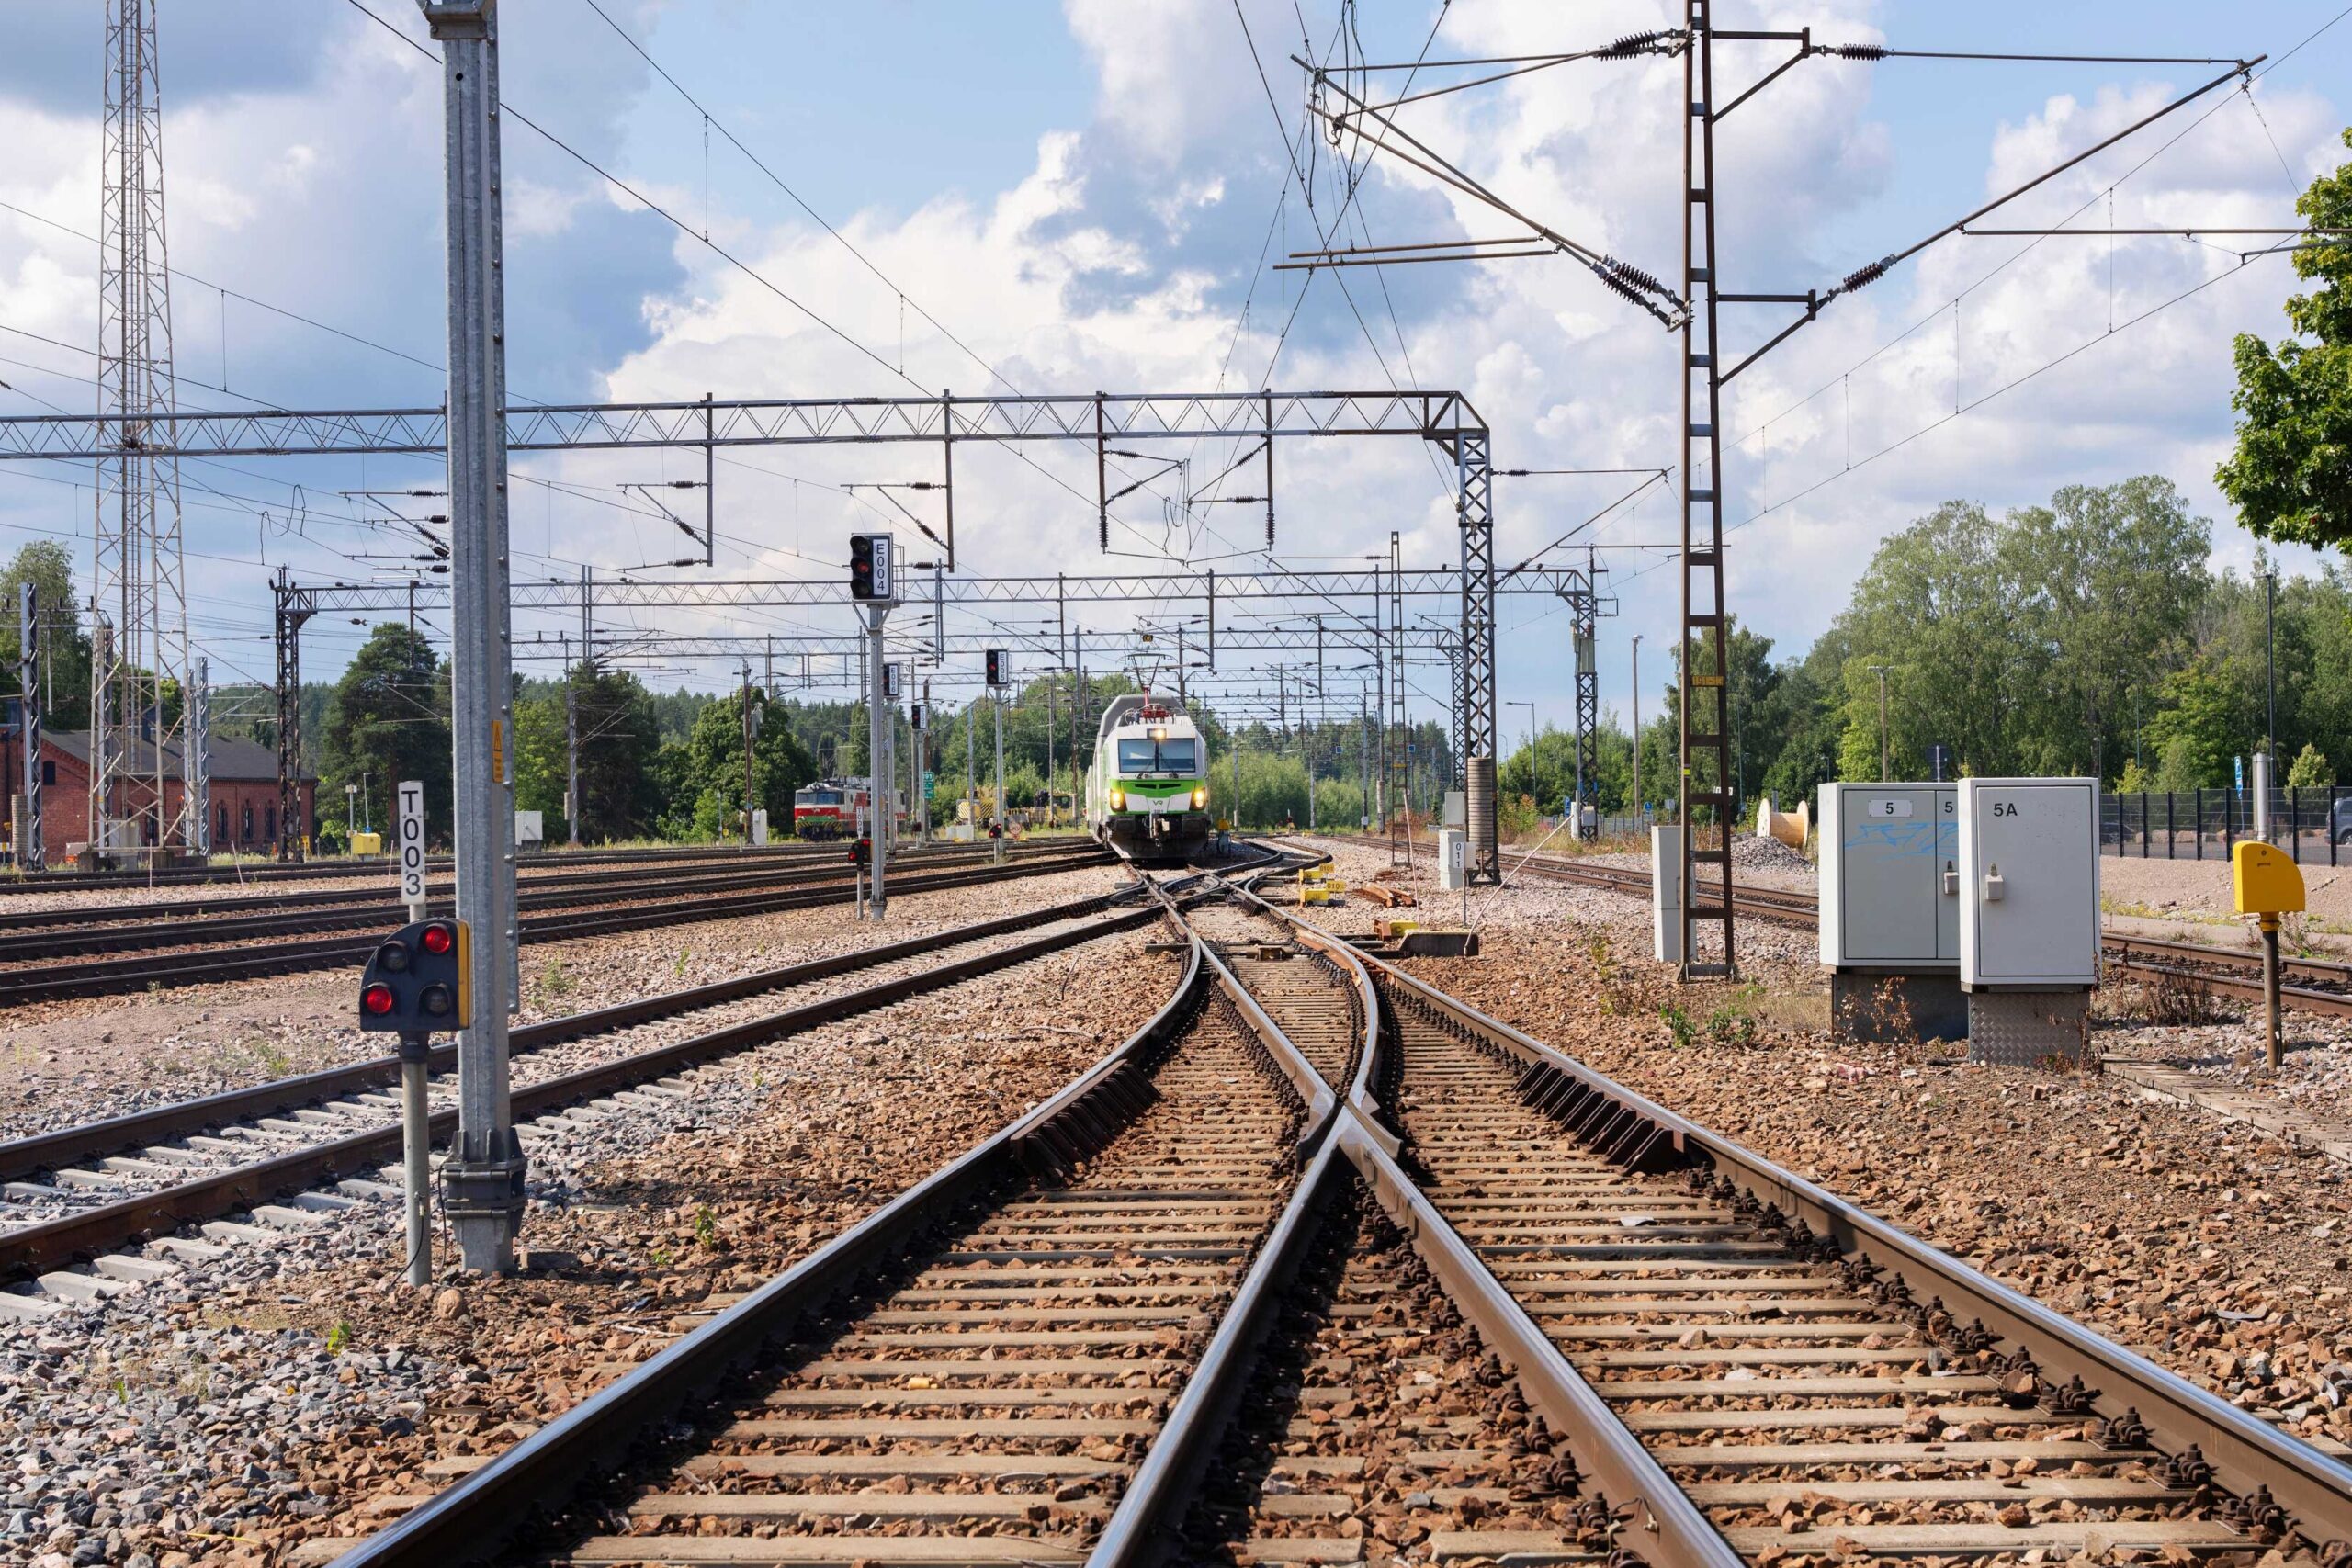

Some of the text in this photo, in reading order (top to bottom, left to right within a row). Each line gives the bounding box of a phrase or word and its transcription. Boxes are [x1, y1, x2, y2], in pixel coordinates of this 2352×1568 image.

[876, 544, 885, 591] E004
[1885, 802, 1894, 815] 5
[1944, 801, 1953, 814] 5
[1993, 803, 2018, 817] 5A
[401, 790, 422, 897] T003
